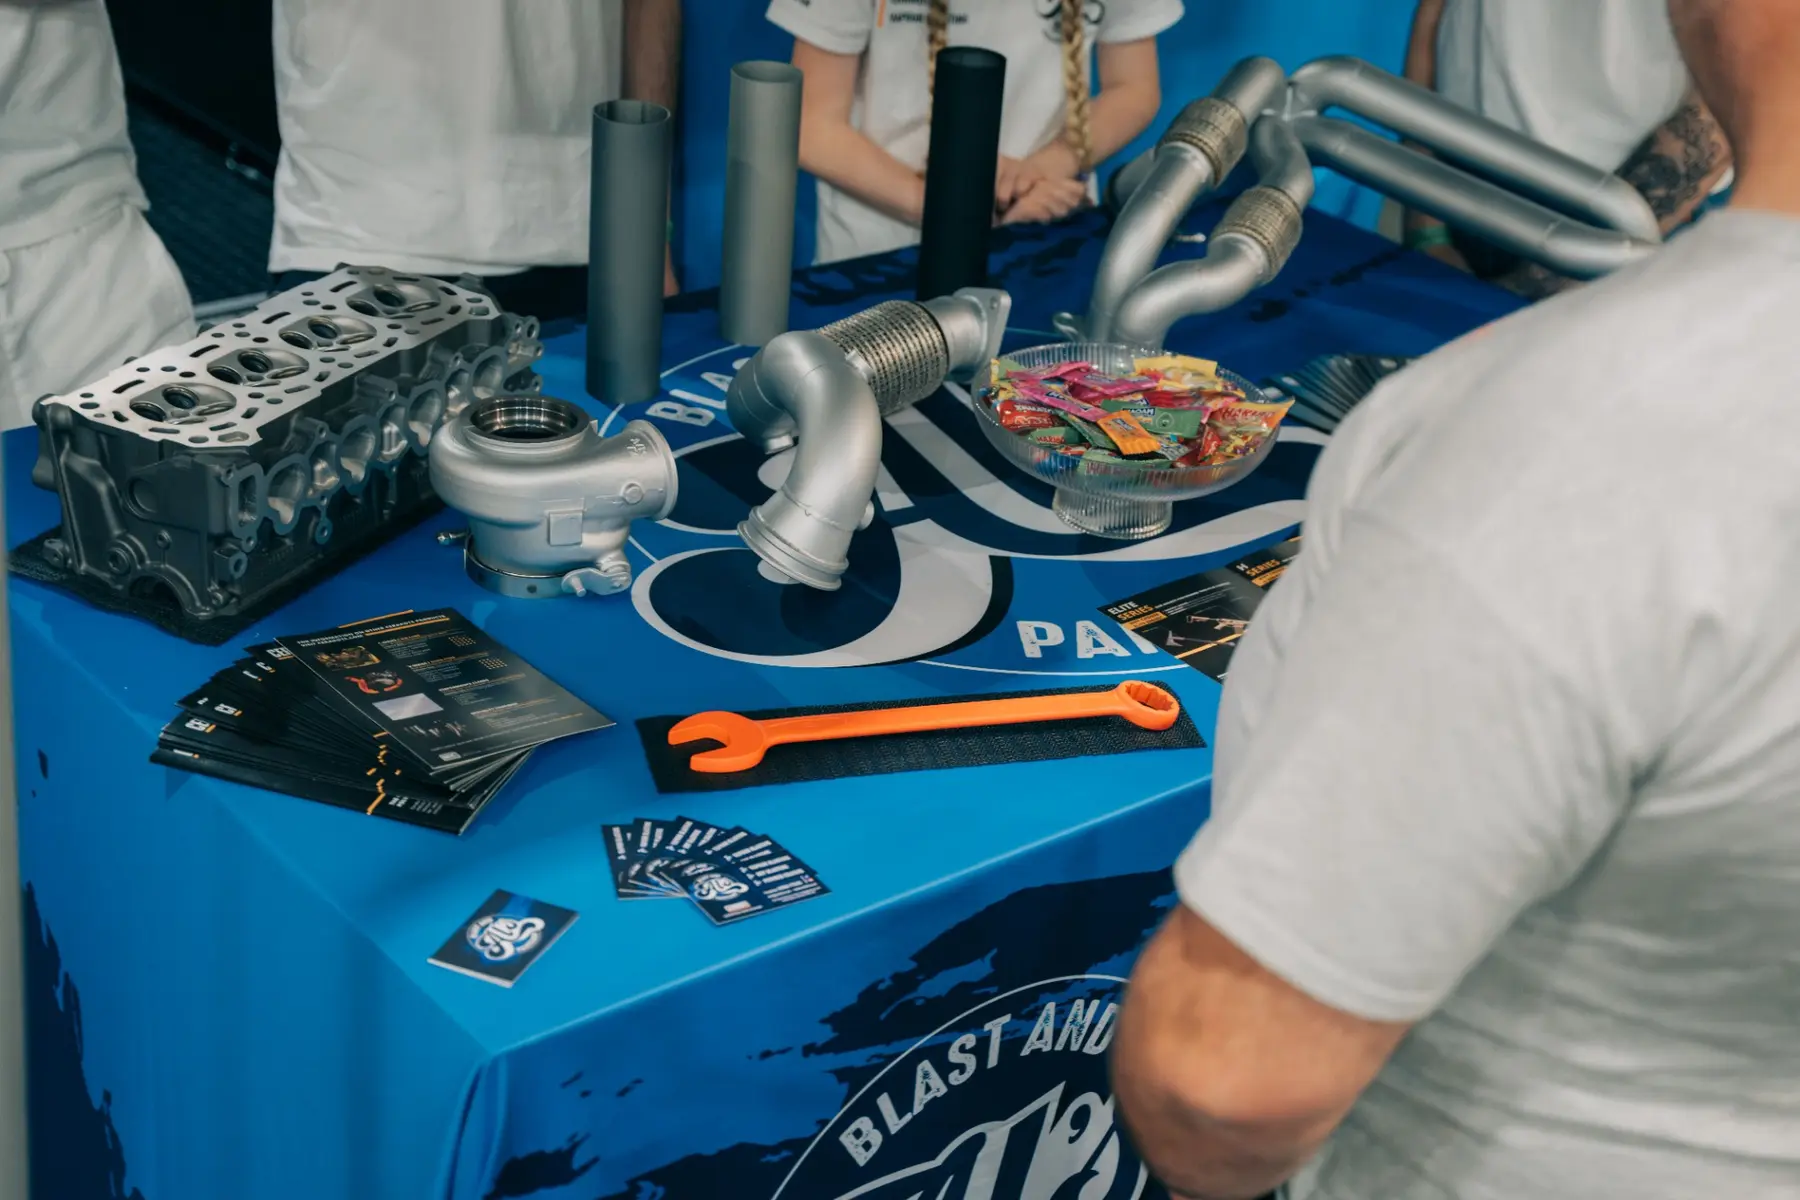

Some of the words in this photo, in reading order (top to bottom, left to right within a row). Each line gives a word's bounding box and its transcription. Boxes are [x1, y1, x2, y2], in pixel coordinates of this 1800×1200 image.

[645, 357, 749, 427] BLA
[1246, 559, 1281, 577] SERIES
[1107, 601, 1140, 616] ELITE
[1117, 605, 1154, 621] SERIES
[838, 1013, 1012, 1168] BLAST
[1019, 998, 1120, 1057] AND
